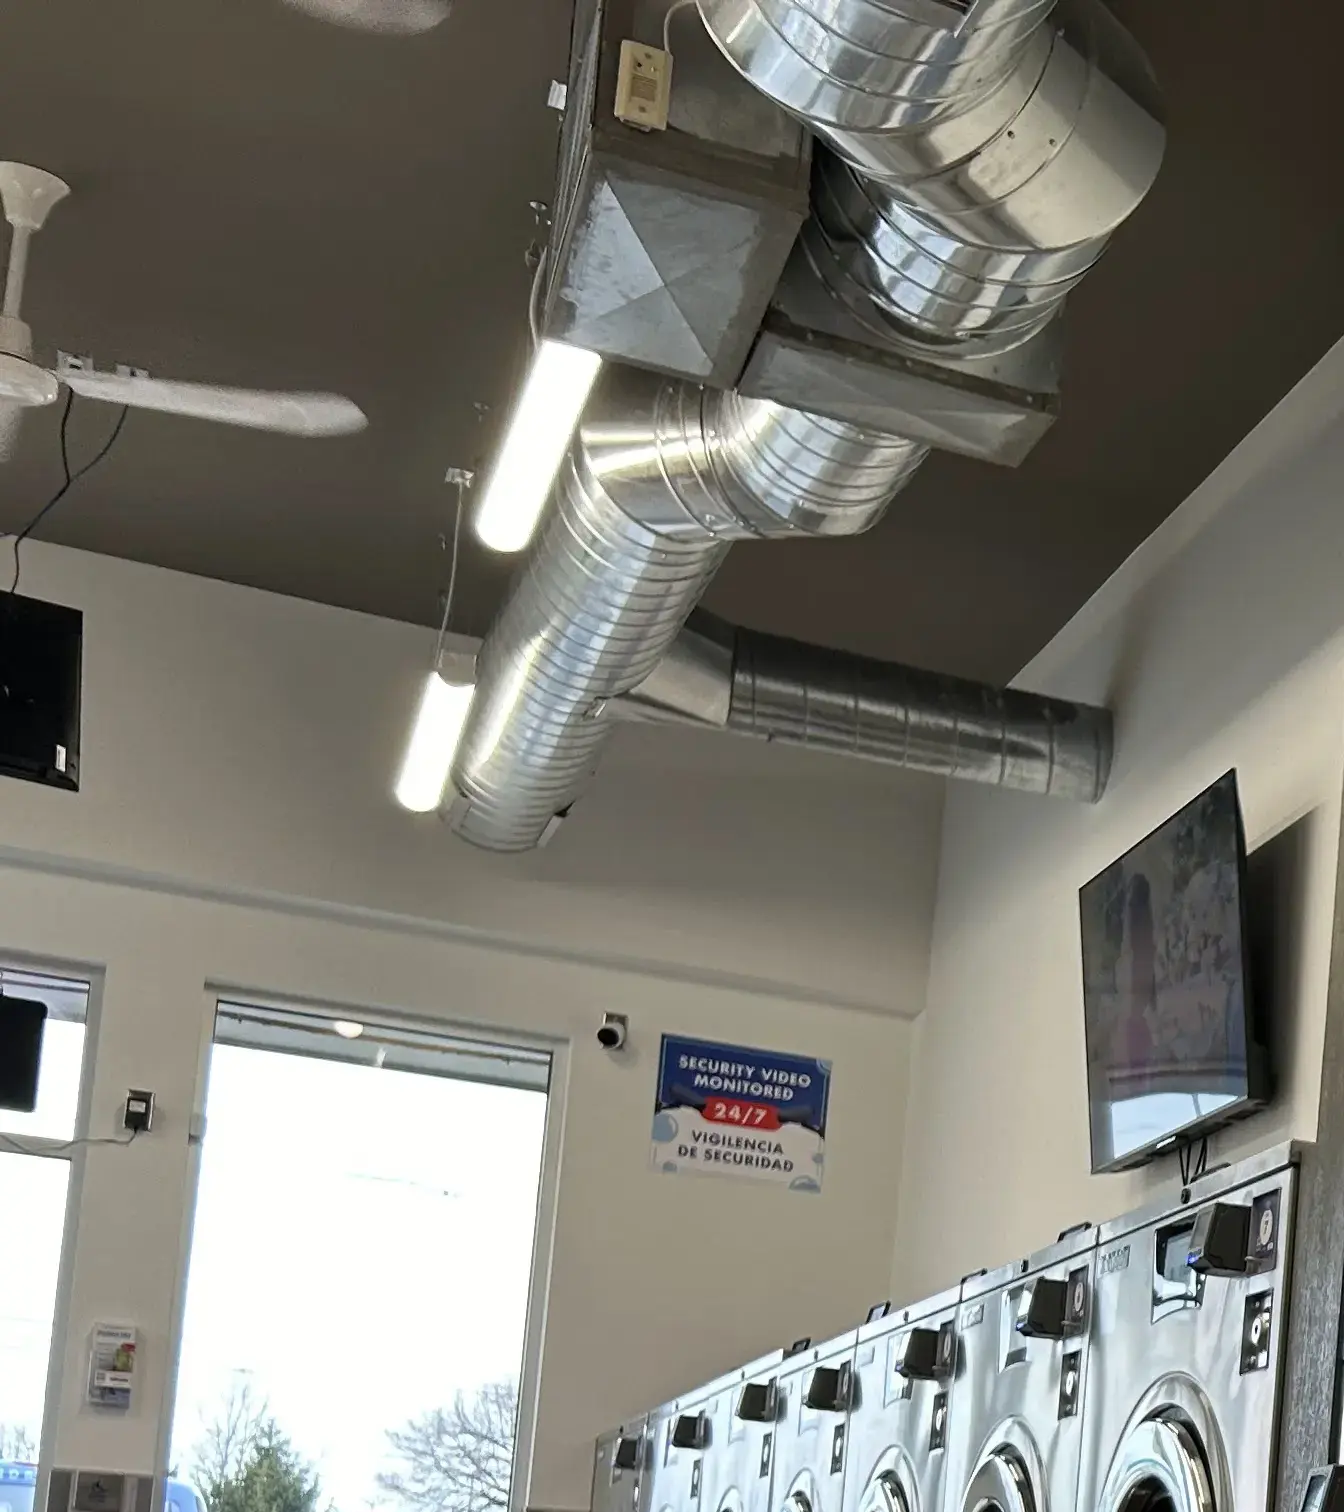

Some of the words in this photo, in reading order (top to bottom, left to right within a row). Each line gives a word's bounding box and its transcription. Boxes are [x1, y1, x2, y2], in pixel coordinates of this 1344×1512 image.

[678, 1055, 756, 1081] SECURITY
[762, 1067, 812, 1089] VIDEO
[694, 1074, 794, 1101] MONITORED
[714, 1102, 767, 1126] 24/7
[691, 1129, 784, 1155] VIGILENCIA
[677, 1144, 698, 1159] DE
[704, 1148, 795, 1173] SECURIDAD
